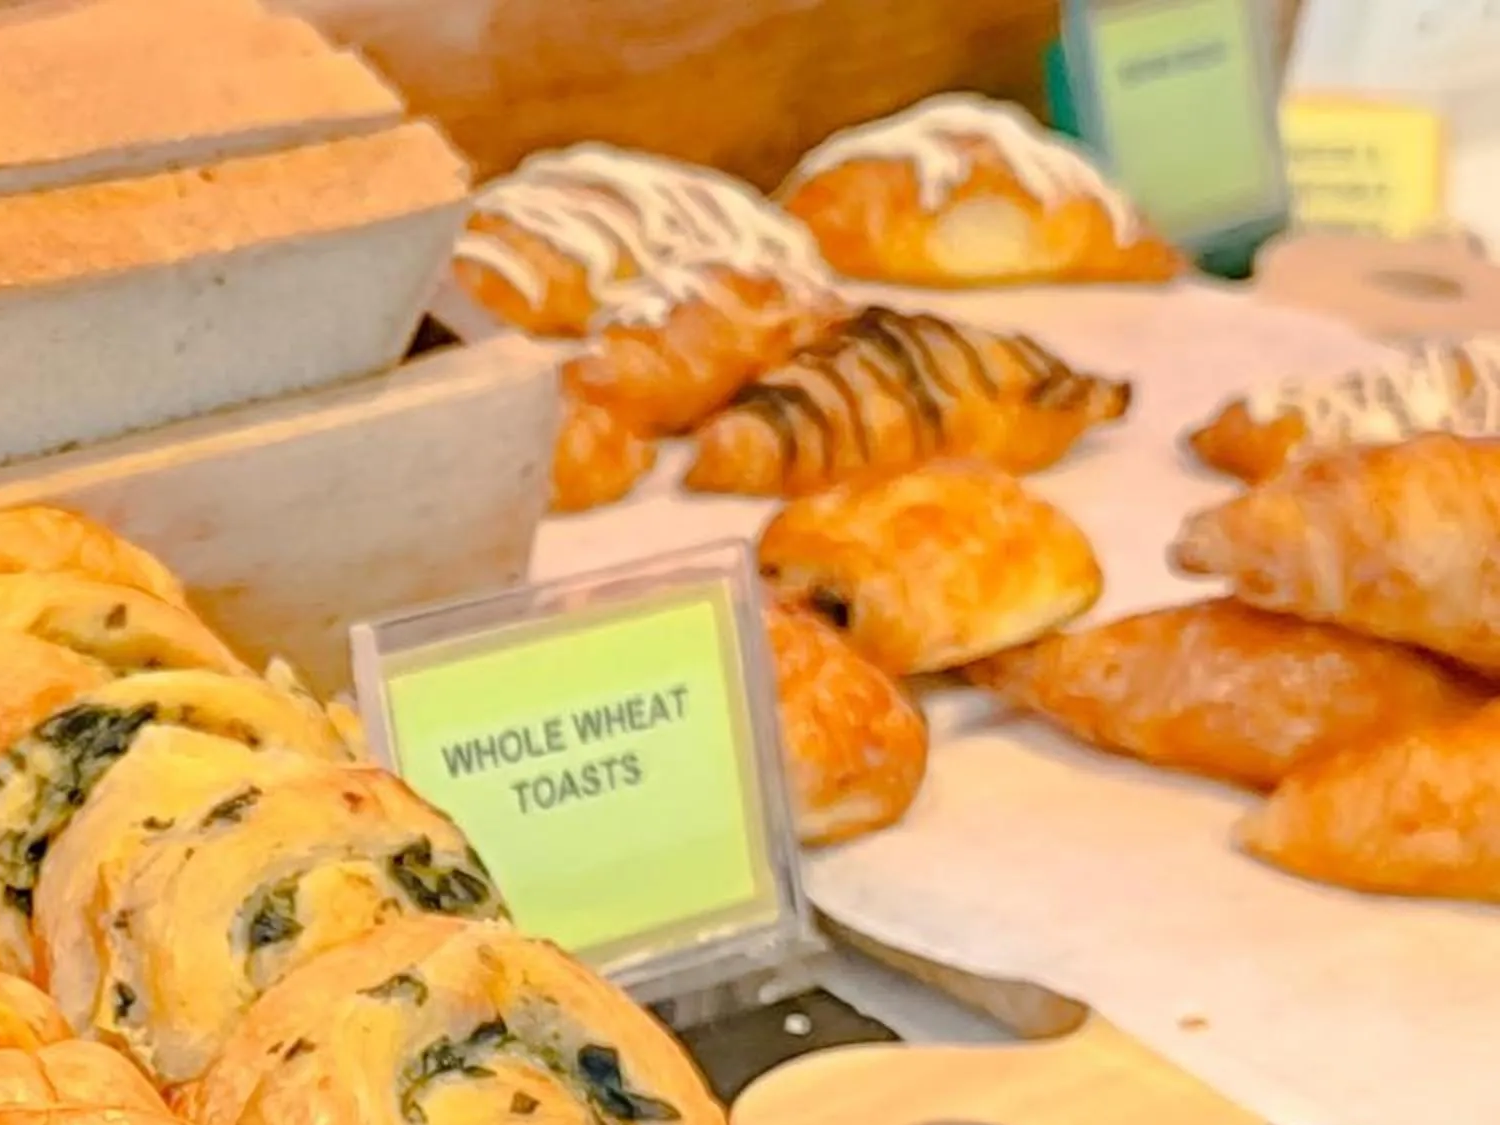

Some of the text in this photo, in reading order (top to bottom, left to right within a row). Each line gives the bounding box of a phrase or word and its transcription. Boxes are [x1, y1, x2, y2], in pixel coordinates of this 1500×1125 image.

[441, 683, 689, 778] WHOLE WHEAT
[510, 752, 643, 814] TOASTS
